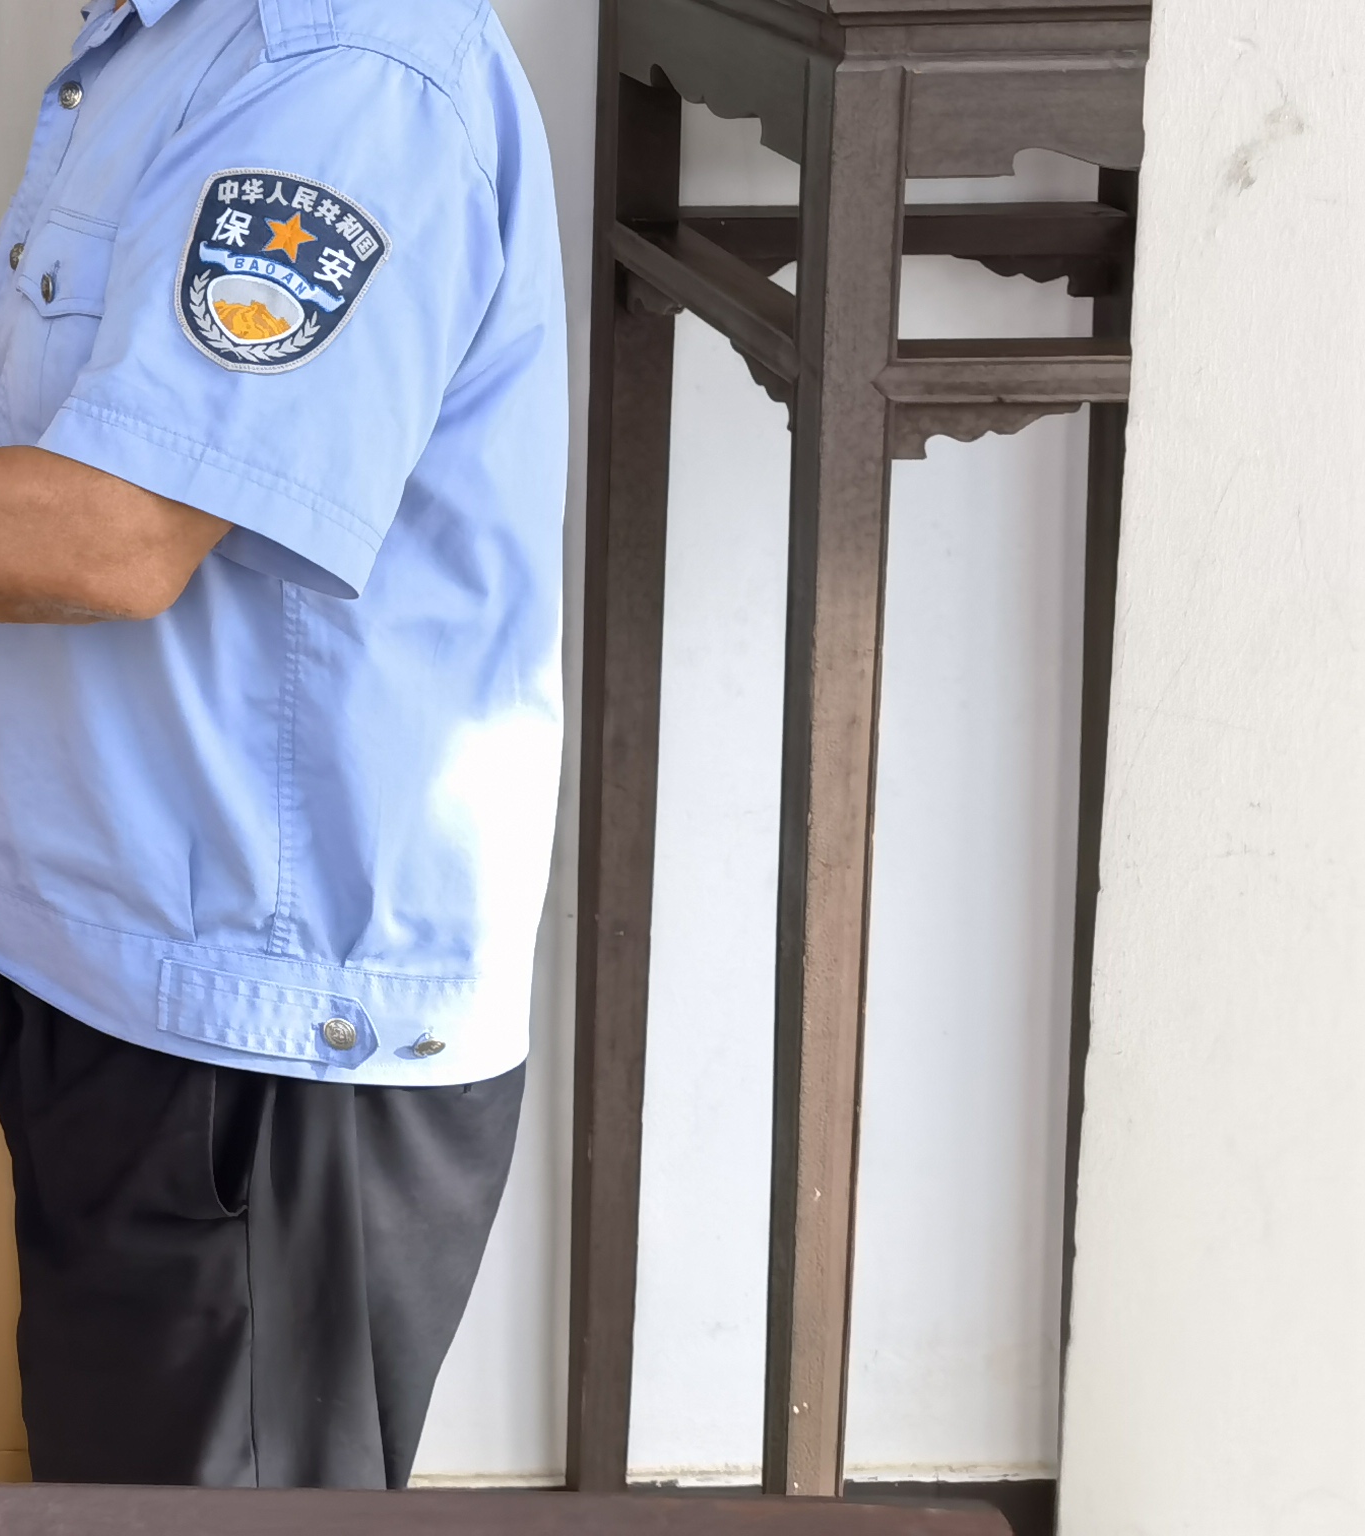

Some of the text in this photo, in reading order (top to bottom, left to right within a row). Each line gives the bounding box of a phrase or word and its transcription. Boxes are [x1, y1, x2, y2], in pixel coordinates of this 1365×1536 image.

[210, 207, 356, 292] 保 安
[217, 178, 379, 262] 中华人民共和国
[234, 256, 308, 296] BAO AN
